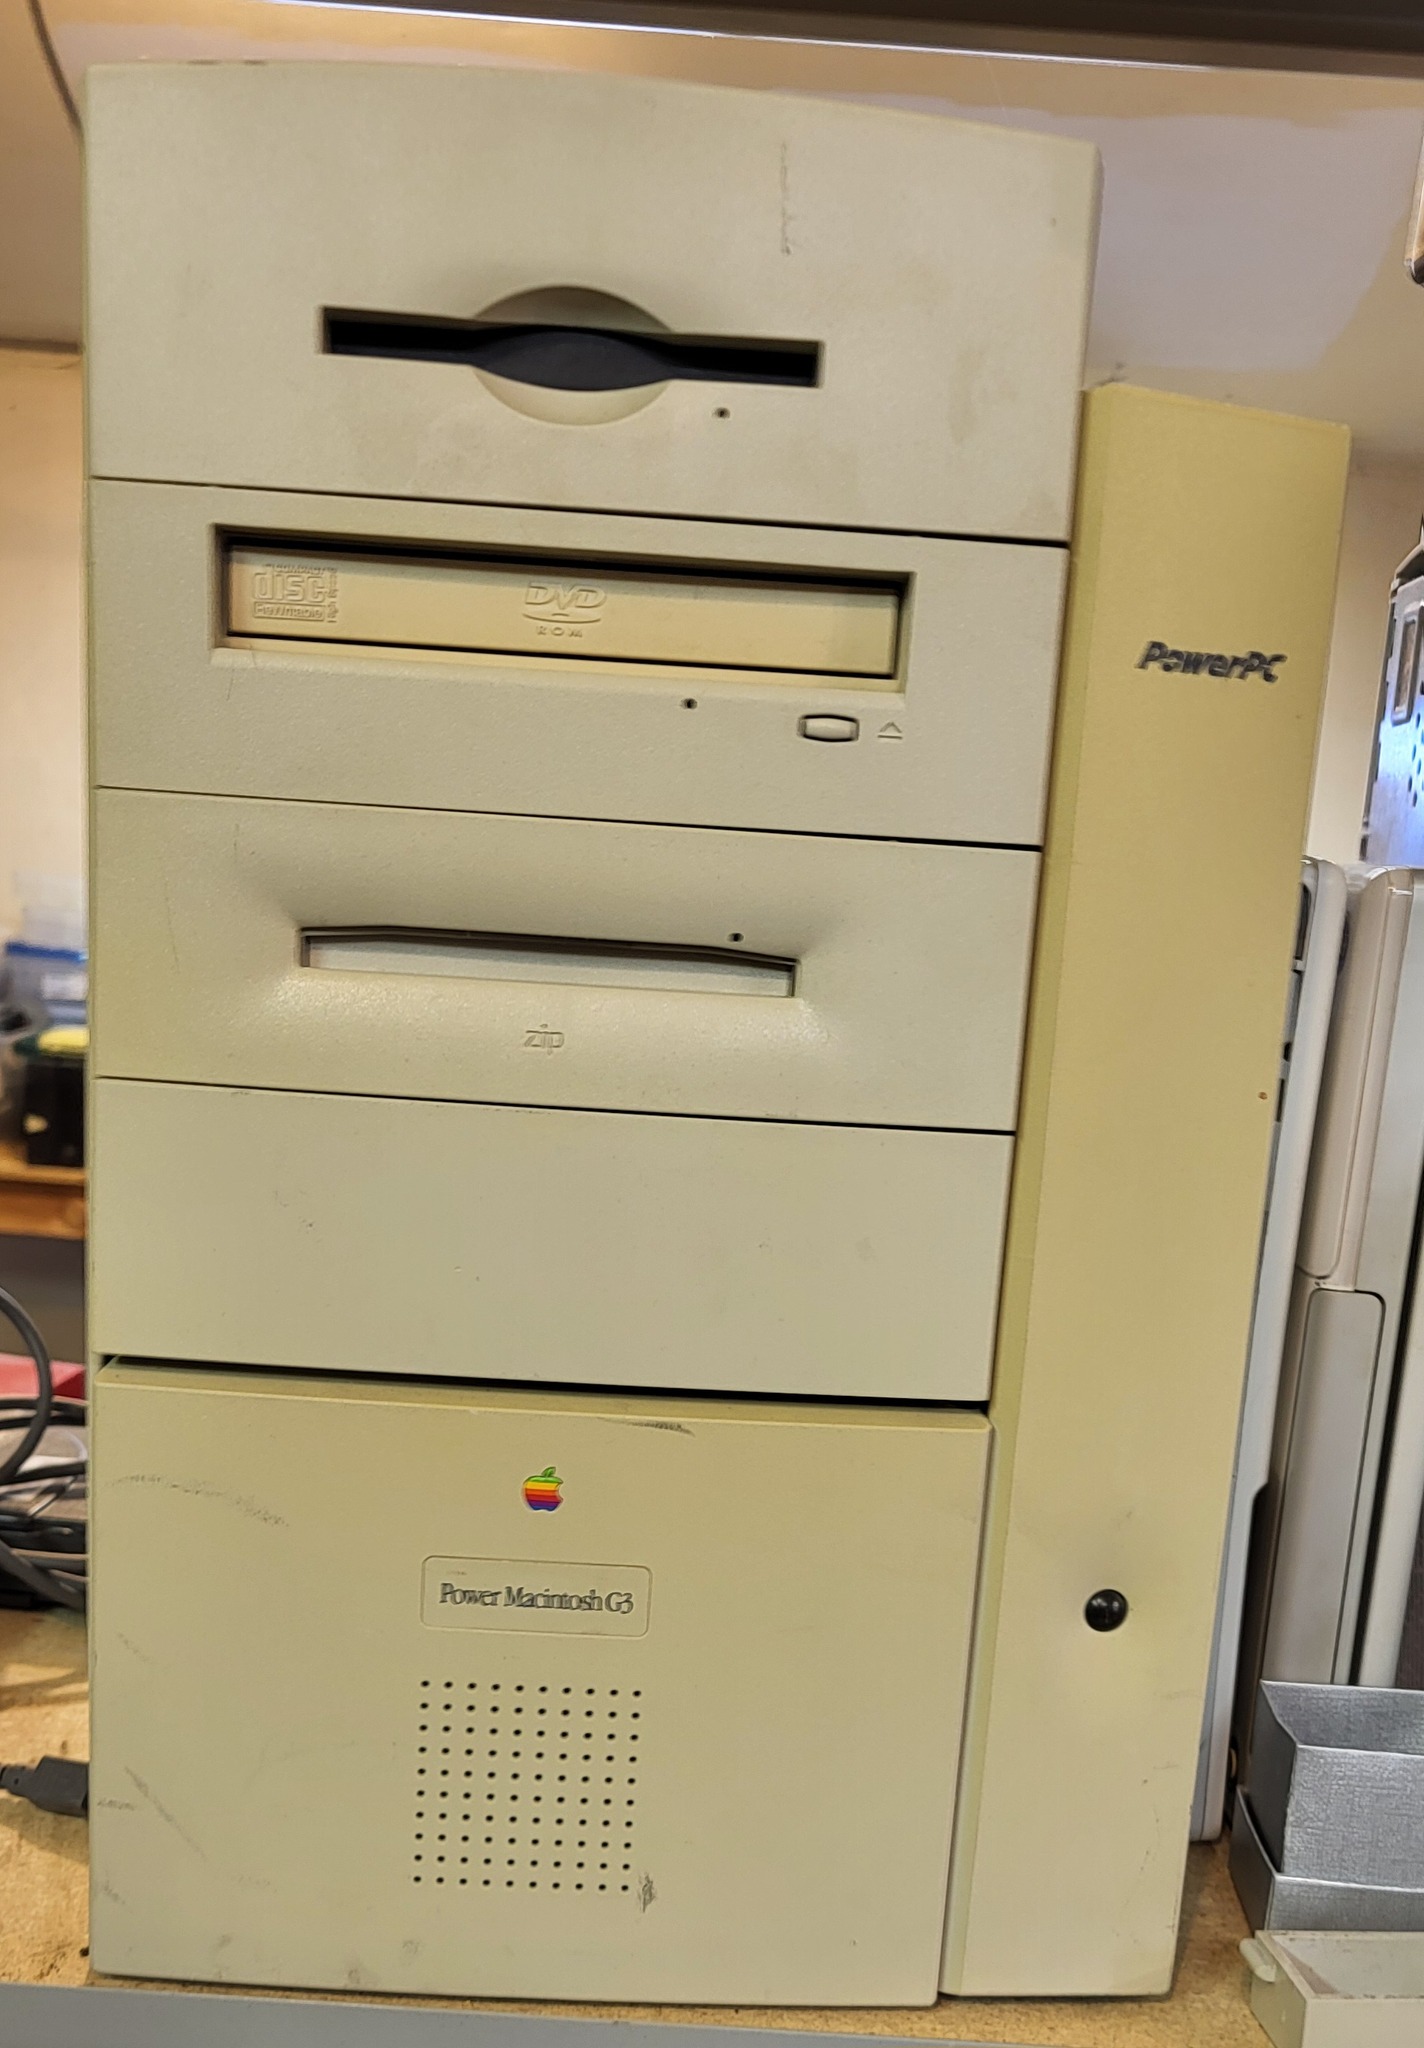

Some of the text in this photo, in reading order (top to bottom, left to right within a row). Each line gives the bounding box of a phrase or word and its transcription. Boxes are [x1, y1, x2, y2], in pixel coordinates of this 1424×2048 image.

[524, 581, 607, 610] DVD
[535, 625, 583, 638] ROM
[1134, 640, 1287, 683] PowerPC
[524, 1024, 564, 1055] zip
[439, 1582, 633, 1615] Power Macintosh G3
